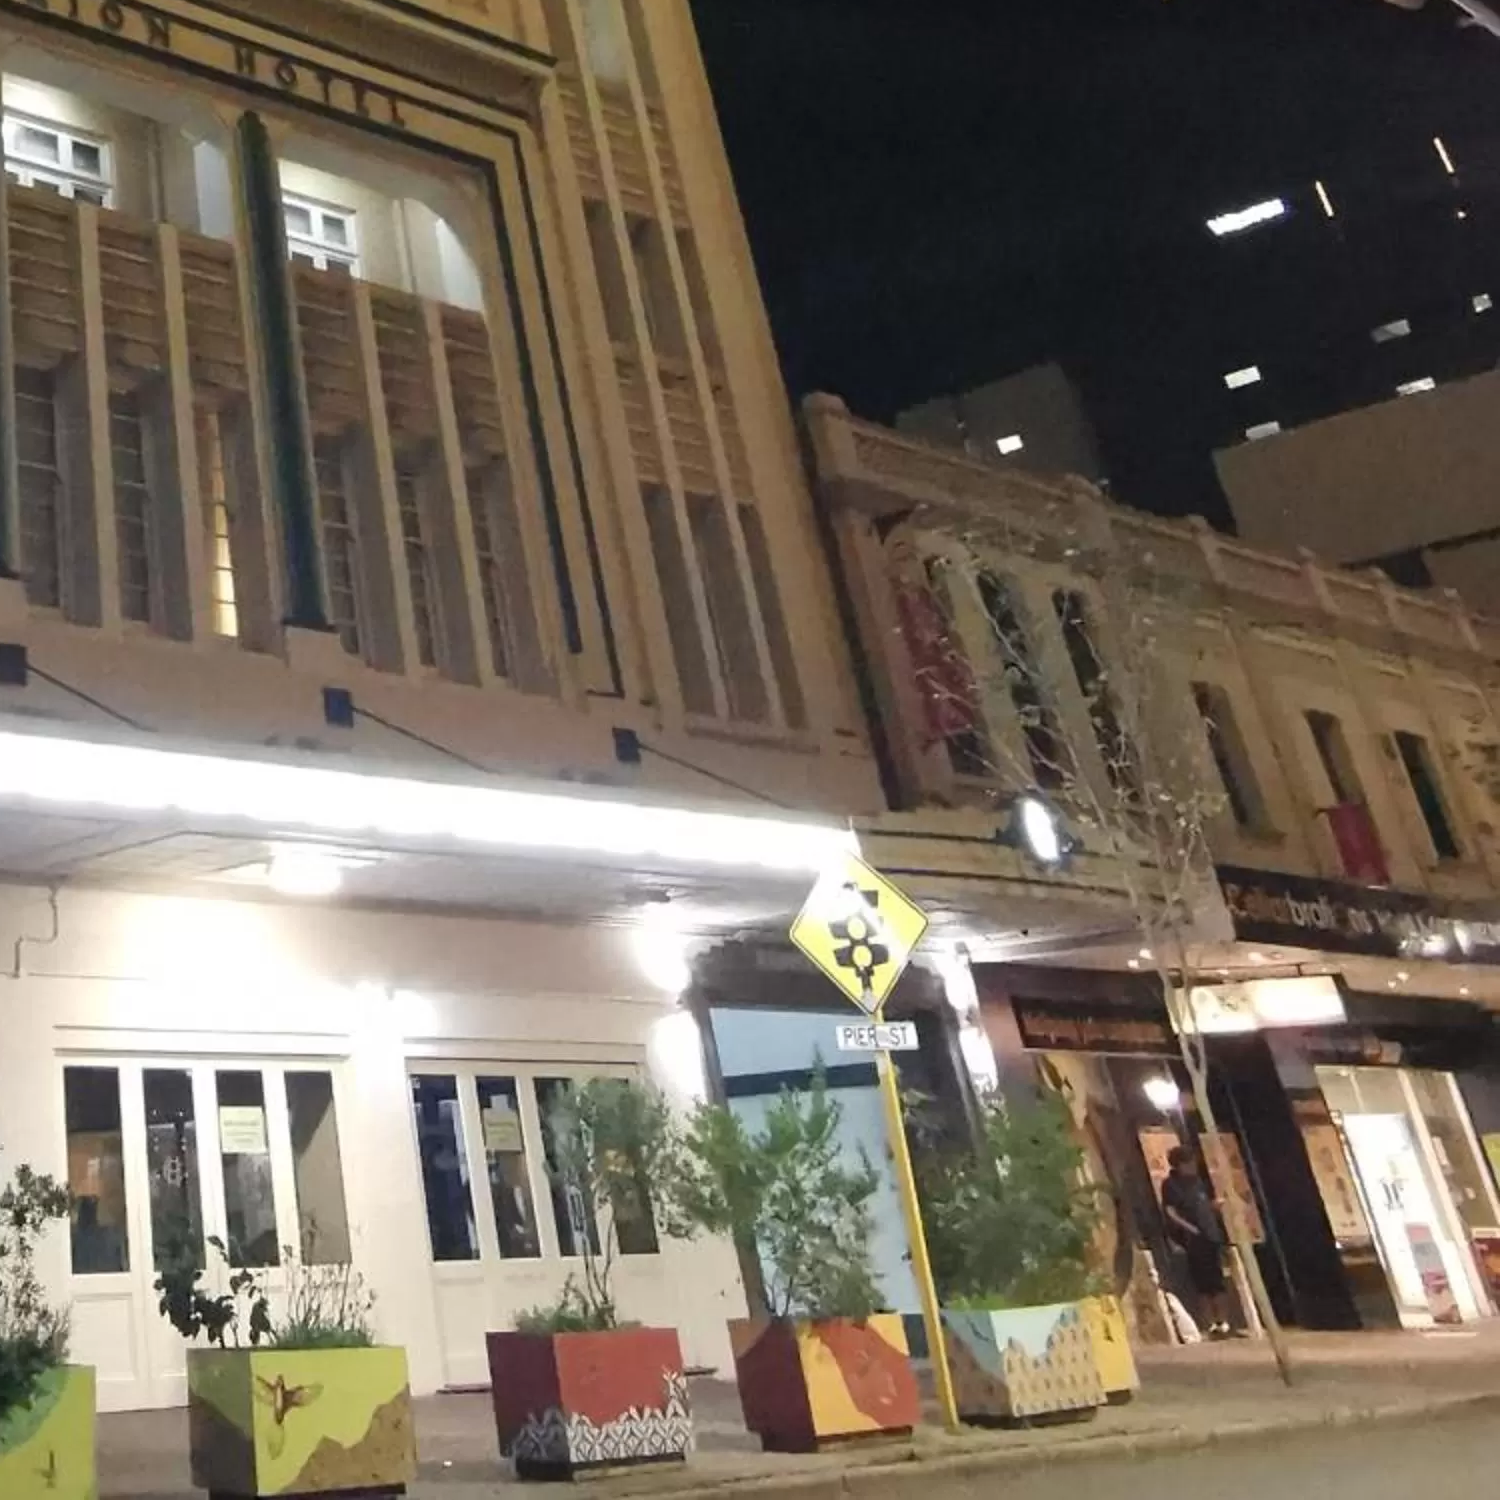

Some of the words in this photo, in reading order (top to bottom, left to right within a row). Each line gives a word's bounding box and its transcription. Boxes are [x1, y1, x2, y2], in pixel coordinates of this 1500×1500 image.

[233, 43, 405, 128] HOTEL
[843, 1026, 877, 1047] PIER
[888, 1026, 908, 1046] ST
